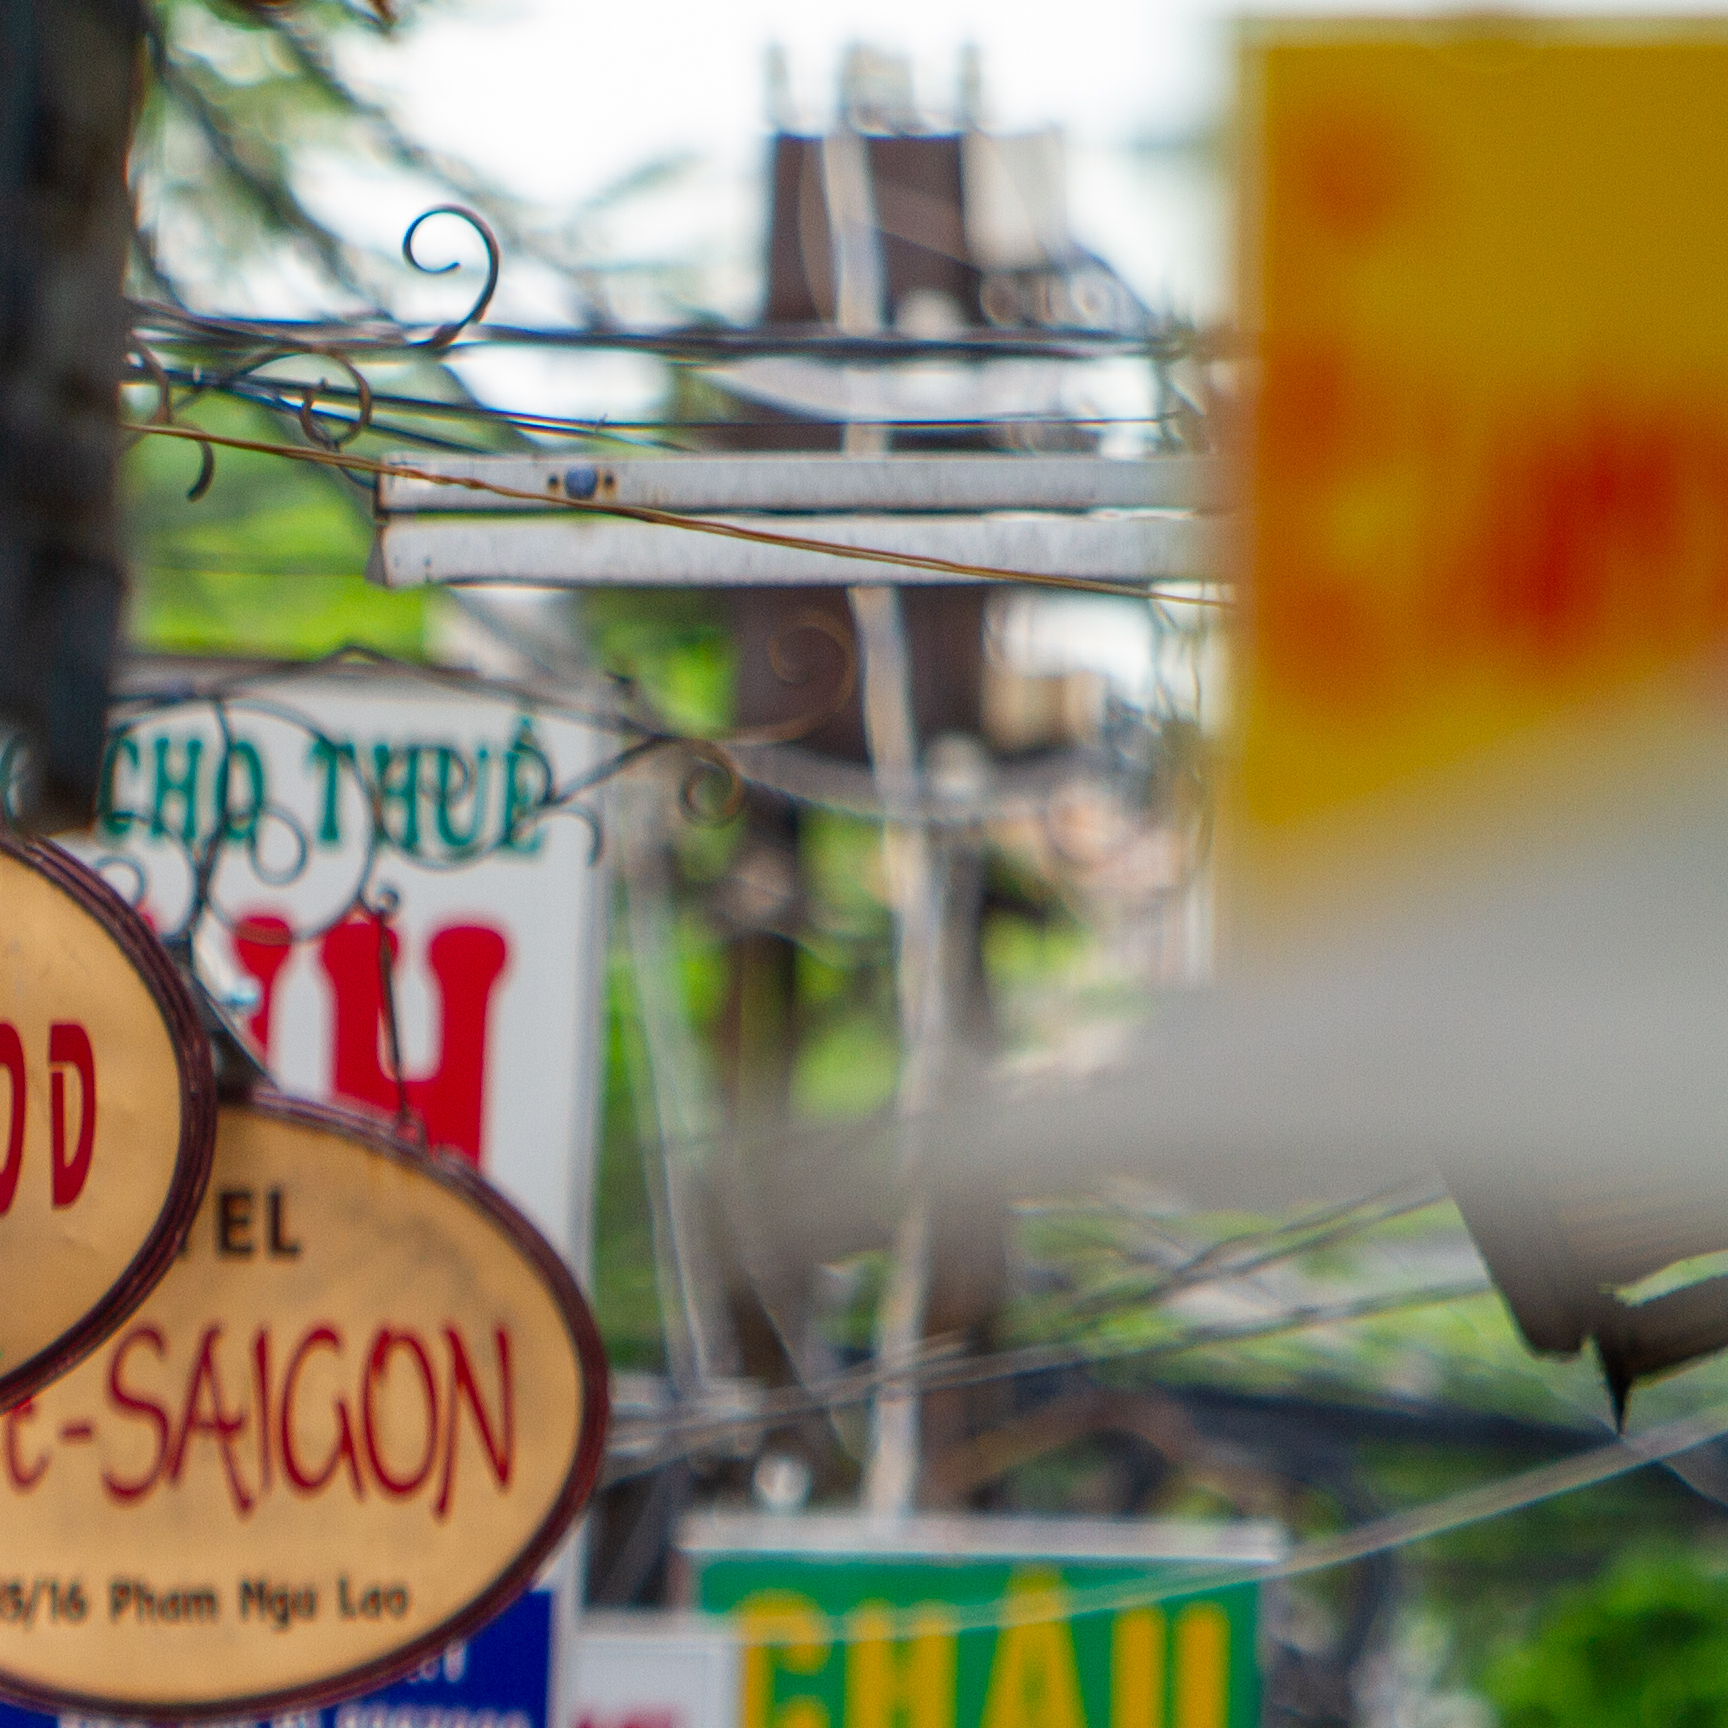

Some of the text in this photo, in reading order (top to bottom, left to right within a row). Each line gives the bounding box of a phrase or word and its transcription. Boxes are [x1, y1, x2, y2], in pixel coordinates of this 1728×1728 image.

[99, 735, 268, 844] CHO
[109, 1580, 217, 1622] Pham
[239, 1581, 317, 1631] Ngu
[339, 1577, 410, 1621] Lao
